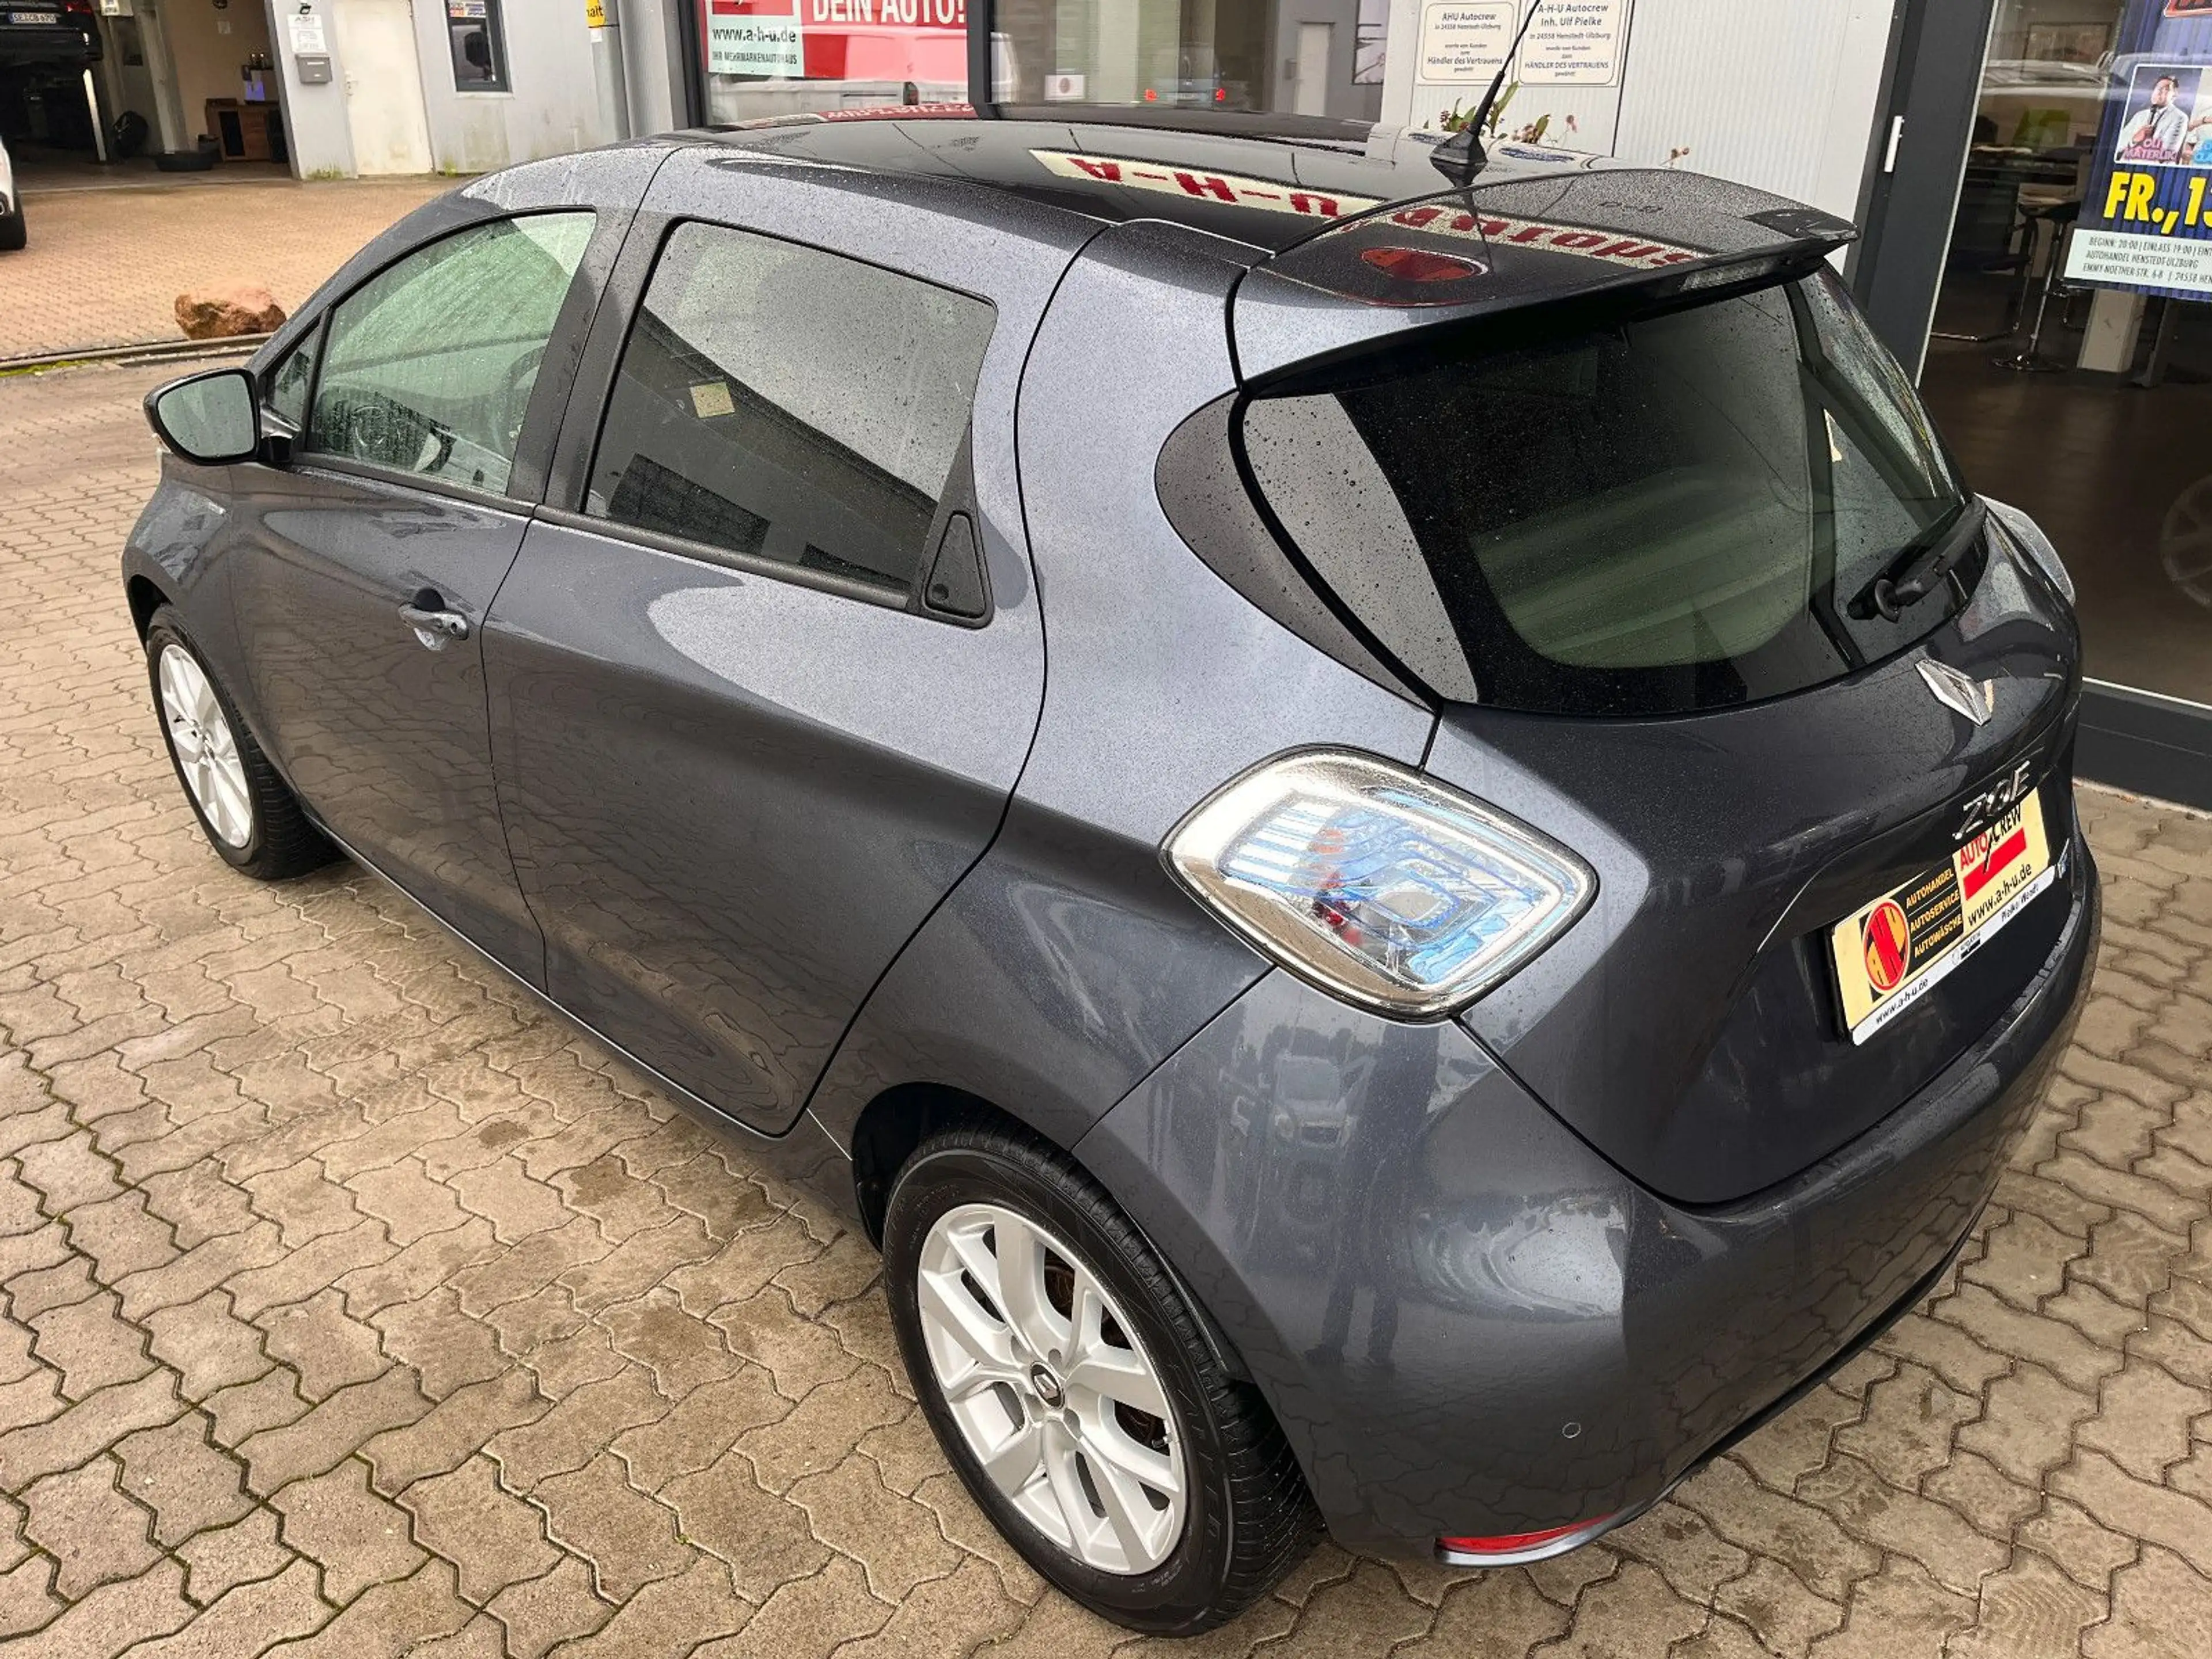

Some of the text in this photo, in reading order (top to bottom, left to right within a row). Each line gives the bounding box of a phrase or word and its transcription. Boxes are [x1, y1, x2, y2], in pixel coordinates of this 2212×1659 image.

[1565, 4, 1608, 12] Autocrew
[1460, 12, 1497, 21] Autocrew
[1541, 16, 1602, 26] Inh. Ulf Pielke
[712, 26, 796, 42] www.a-h-u.de
[1427, 56, 1503, 65] Händler des Vertrauens
[1906, 868, 1955, 909] AUTOHANDEL
[1910, 889, 1960, 934] AUTOSERVICE
[1914, 914, 1963, 959] AUTOWÄSCHE
